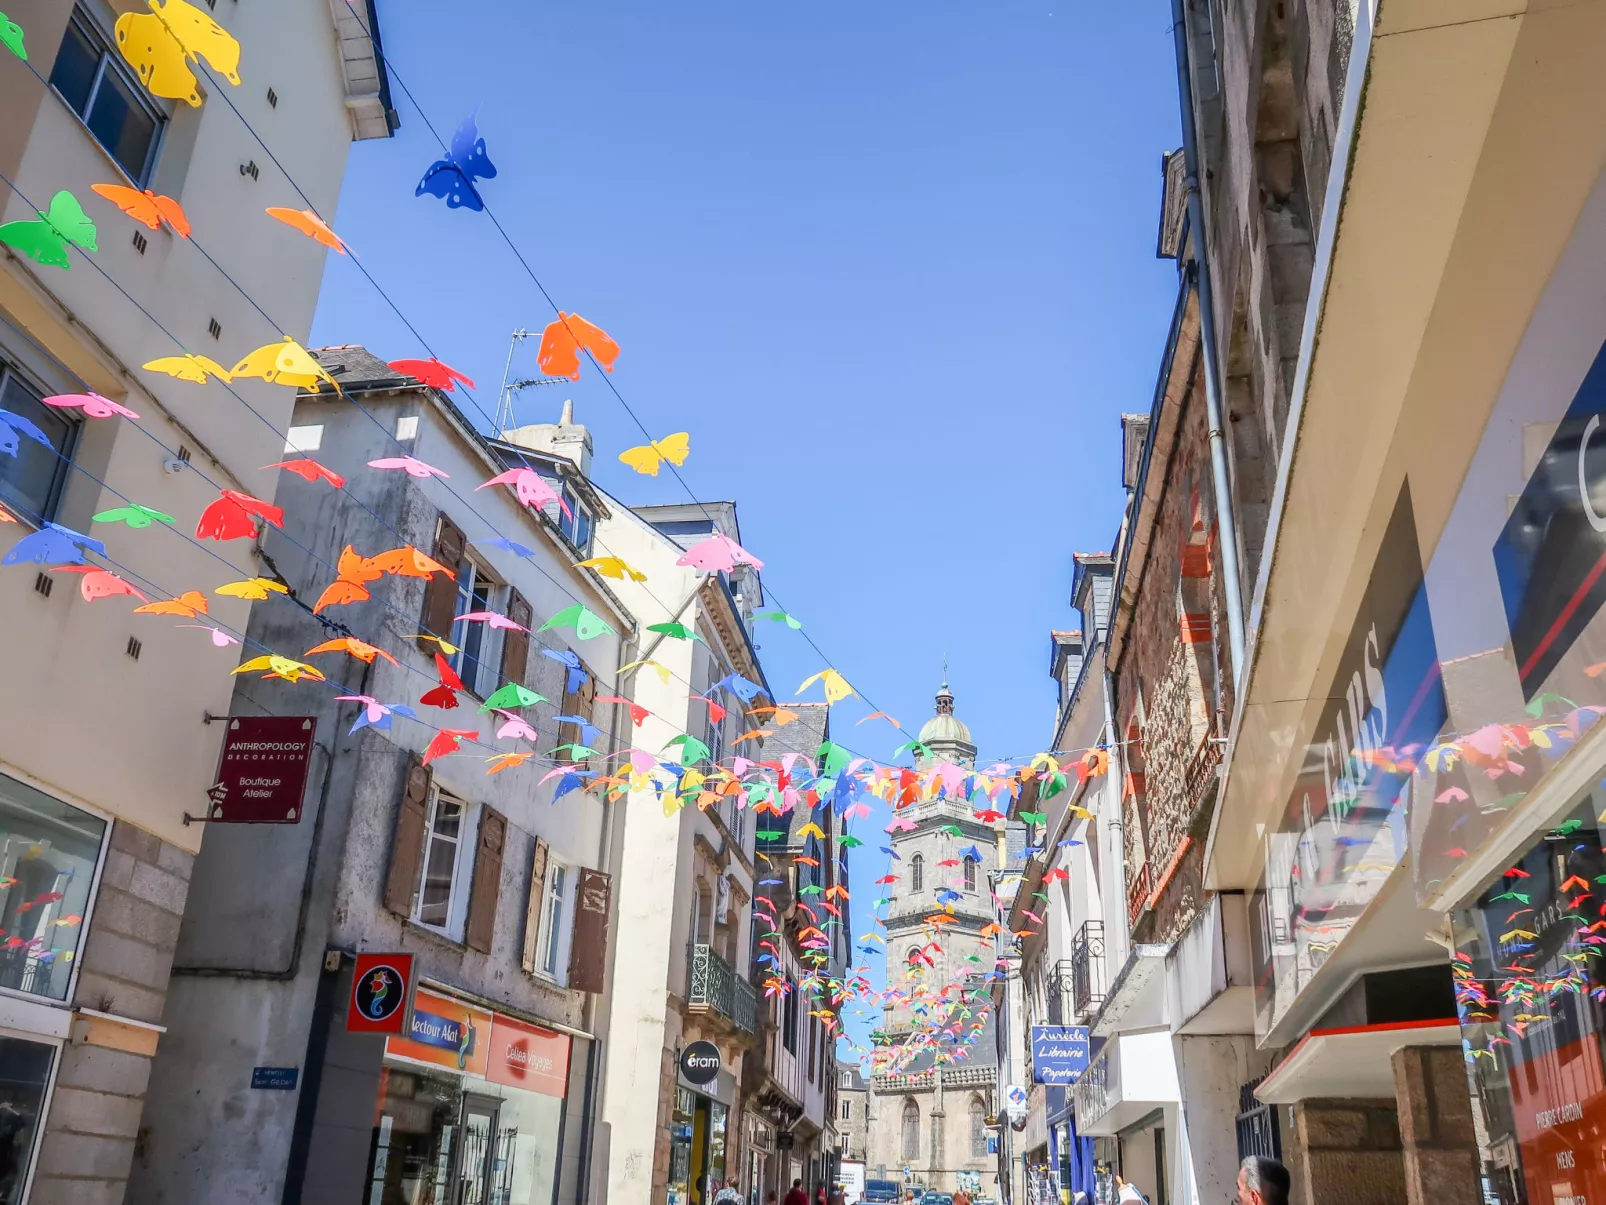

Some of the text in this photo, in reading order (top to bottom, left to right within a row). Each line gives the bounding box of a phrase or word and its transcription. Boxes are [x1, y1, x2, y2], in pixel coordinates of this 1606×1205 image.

[229, 742, 306, 751] ANTHROPOLOGY
[239, 777, 281, 787] Boutique
[242, 789, 273, 798] Atelier
[1534, 899, 1563, 934] GARS
[1038, 1045, 1084, 1058] Librairie
[527, 1050, 553, 1071] Voyages
[687, 1052, 719, 1068] éram
[1041, 1066, 1082, 1082] Papeterie
[1535, 1101, 1583, 1130] PIERRE CARDIN
[1556, 1150, 1576, 1170] MENS
